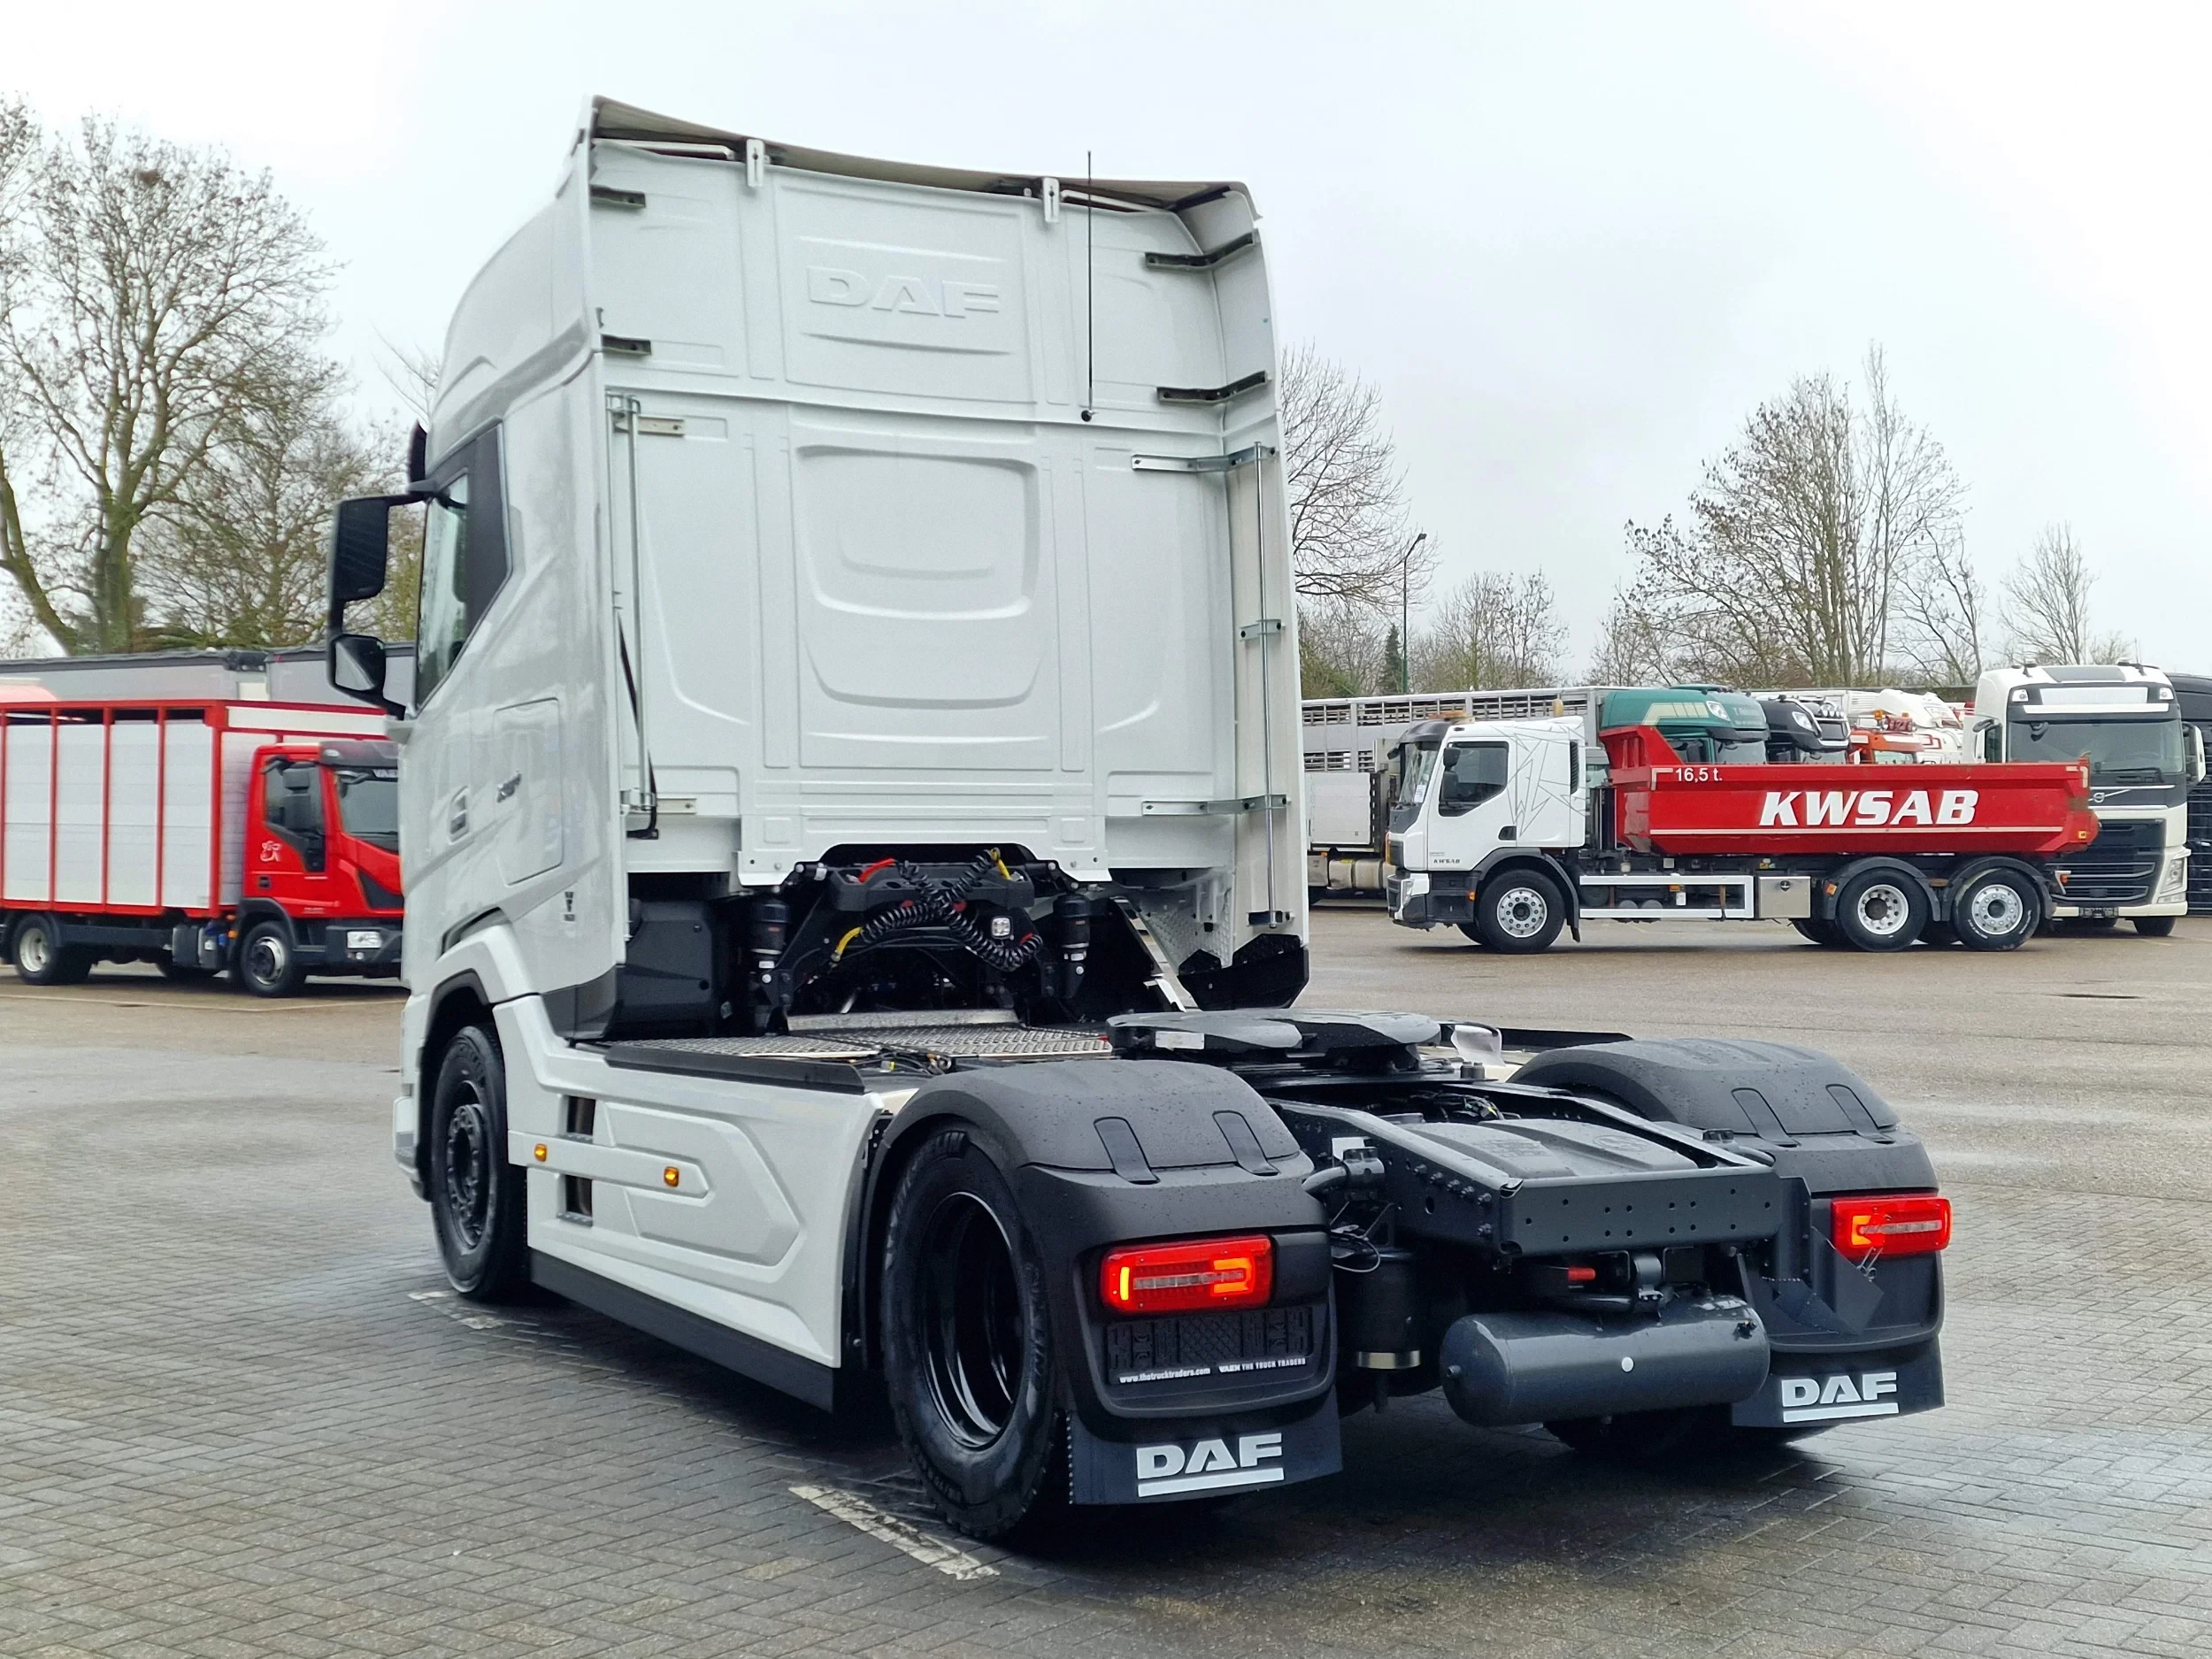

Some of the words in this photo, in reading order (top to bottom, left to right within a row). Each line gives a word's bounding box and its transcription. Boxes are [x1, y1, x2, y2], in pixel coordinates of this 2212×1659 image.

[806, 265, 1000, 319] DAF
[1675, 767, 1709, 784] 16,5
[1713, 767, 1724, 782] t.
[1759, 789, 1979, 826] KWSAB
[1119, 1367, 1211, 1383] www.thetrucktraders.com
[1256, 1360, 1277, 1369] TRUCK
[1278, 1357, 1306, 1367] TRADERS
[1781, 1371, 1898, 1408] DAF
[1136, 1432, 1283, 1479] DAF
